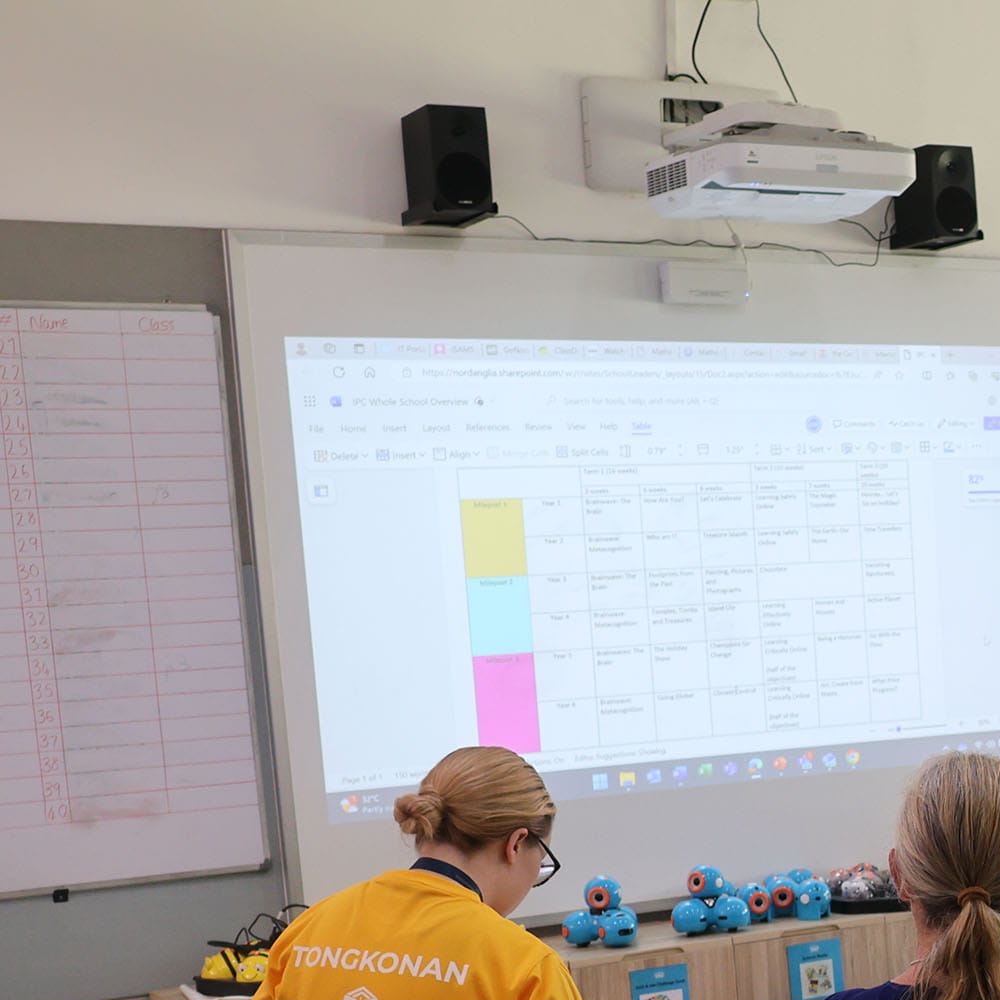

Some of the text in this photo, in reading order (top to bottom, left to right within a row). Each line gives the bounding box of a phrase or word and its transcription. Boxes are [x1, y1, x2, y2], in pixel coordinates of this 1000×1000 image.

[29, 314, 69, 329] Name
[138, 316, 175, 332] Class
[1, 388, 24, 407] 23
[369, 399, 397, 407] Whole
[400, 398, 429, 407] School
[430, 398, 469, 407] Overview
[5, 416, 26, 432] 24
[341, 425, 367, 434] Home
[383, 425, 408, 434] Insert
[422, 424, 451, 435] Layout
[466, 423, 511, 433] References
[525, 423, 553, 432] Review
[568, 422, 587, 431] View
[600, 422, 619, 433] Help
[8, 439, 29, 456] 25
[331, 451, 359, 460] Delete
[393, 451, 417, 460] Insert
[449, 450, 472, 461] Align
[591, 448, 610, 457] Cells
[11, 463, 30, 479] 26
[11, 488, 32, 502] 27
[15, 511, 36, 527] 28
[18, 537, 38, 553] 29
[19, 563, 39, 580] 30
[26, 612, 46, 627] 32
[29, 635, 49, 650] 33
[32, 659, 50, 677] 34
[34, 683, 53, 699] 35
[38, 709, 54, 724] 36
[40, 734, 58, 748] 37
[42, 757, 59, 773] 38
[45, 783, 61, 797] 39
[292, 945, 470, 986] TONGKONAN
